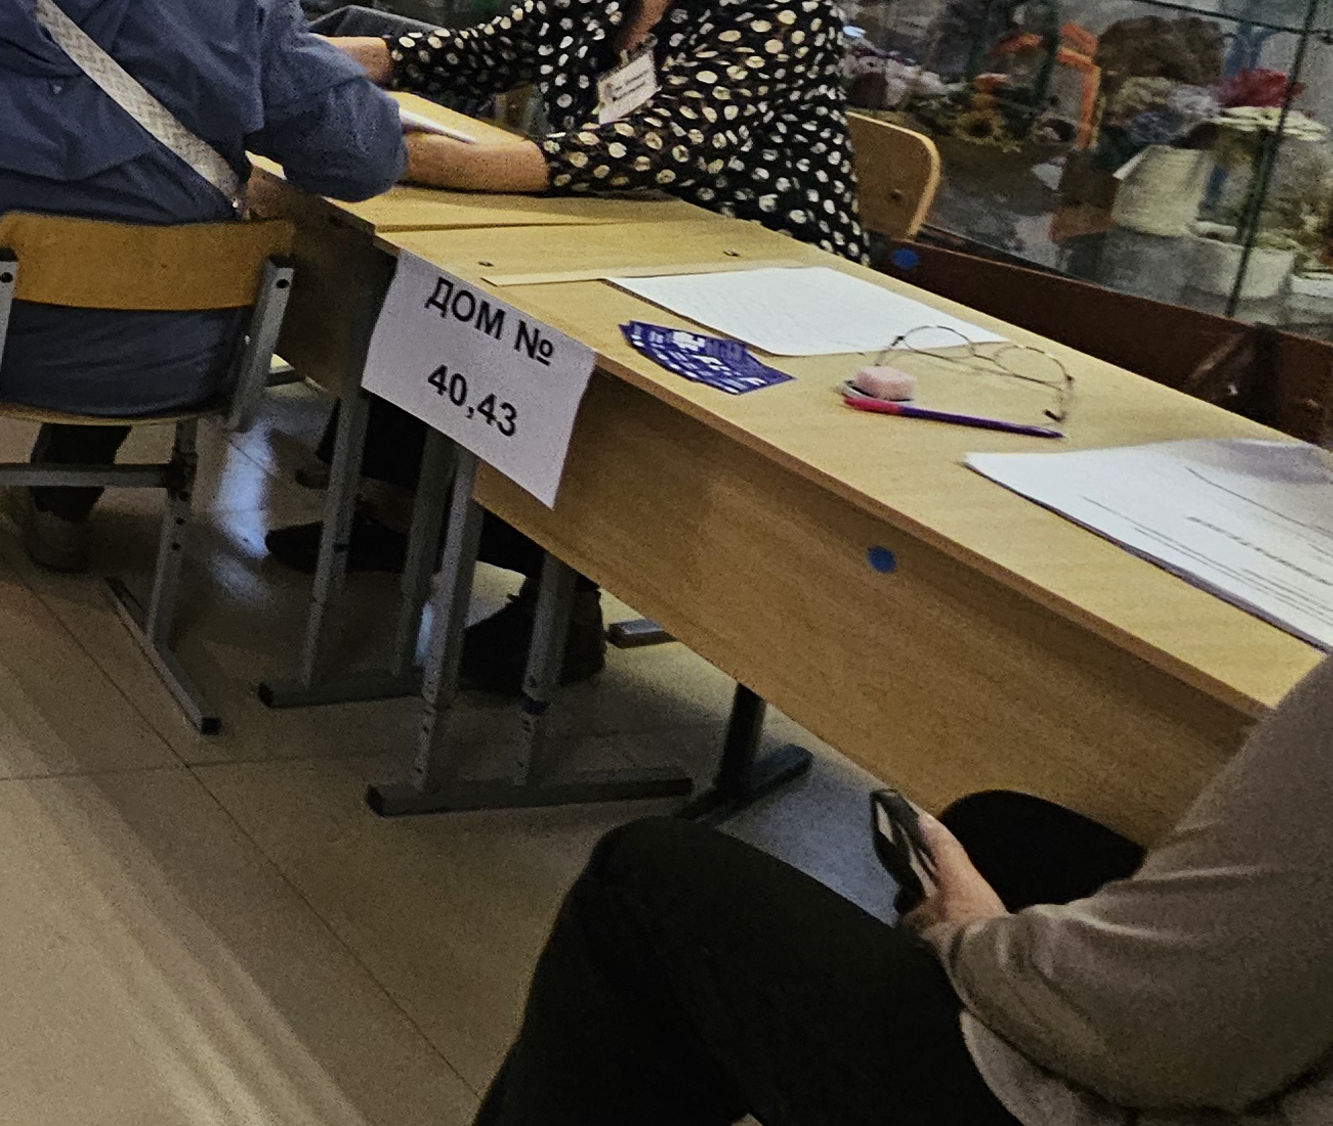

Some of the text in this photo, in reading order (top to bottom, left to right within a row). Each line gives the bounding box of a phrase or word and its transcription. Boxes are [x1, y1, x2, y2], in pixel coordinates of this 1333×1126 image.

[424, 276, 554, 367] ДОМ №
[427, 364, 518, 438] 40,43
